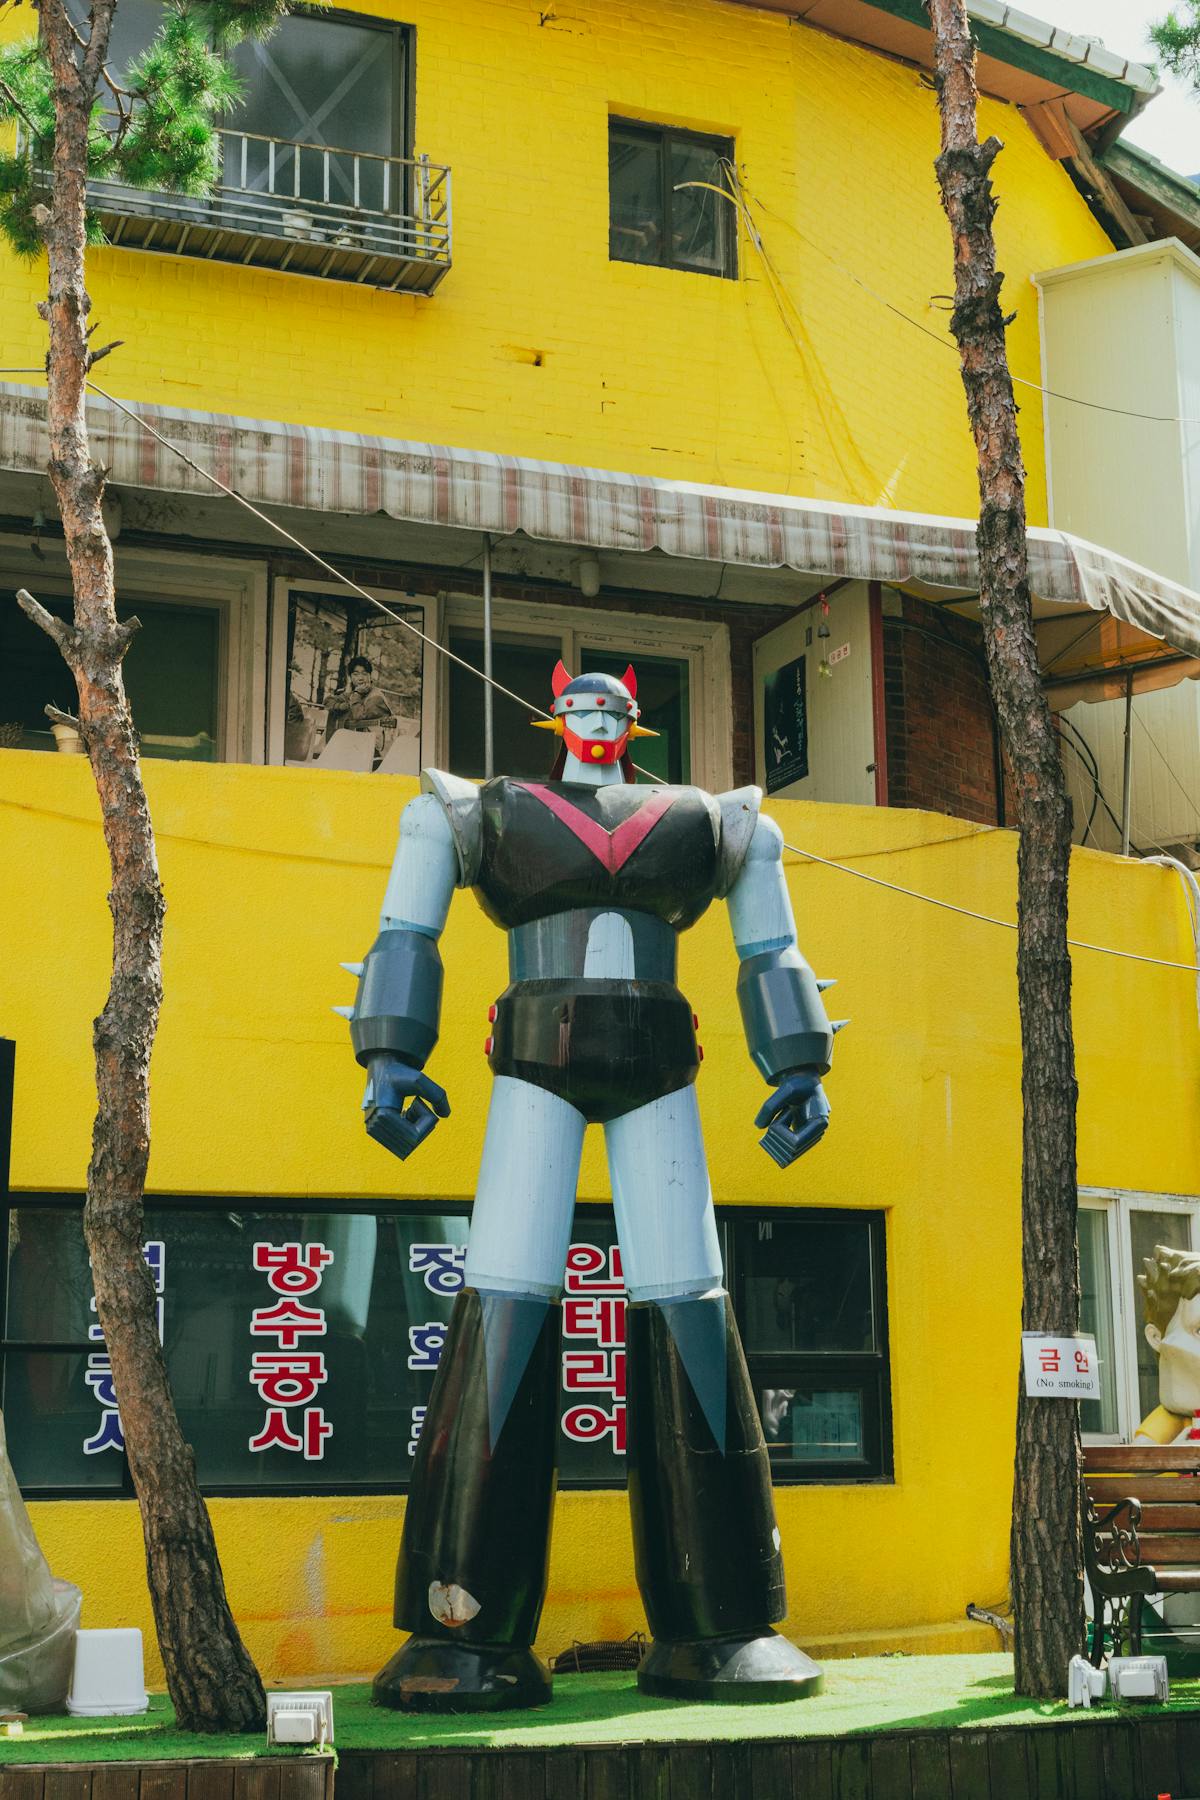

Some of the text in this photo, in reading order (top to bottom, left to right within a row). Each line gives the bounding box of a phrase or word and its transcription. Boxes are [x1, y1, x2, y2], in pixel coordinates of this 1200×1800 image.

[249, 1242, 334, 1460] 방수공사
[561, 1243, 628, 1454] 인테리어
[1058, 1379, 1094, 1390] smoking)
